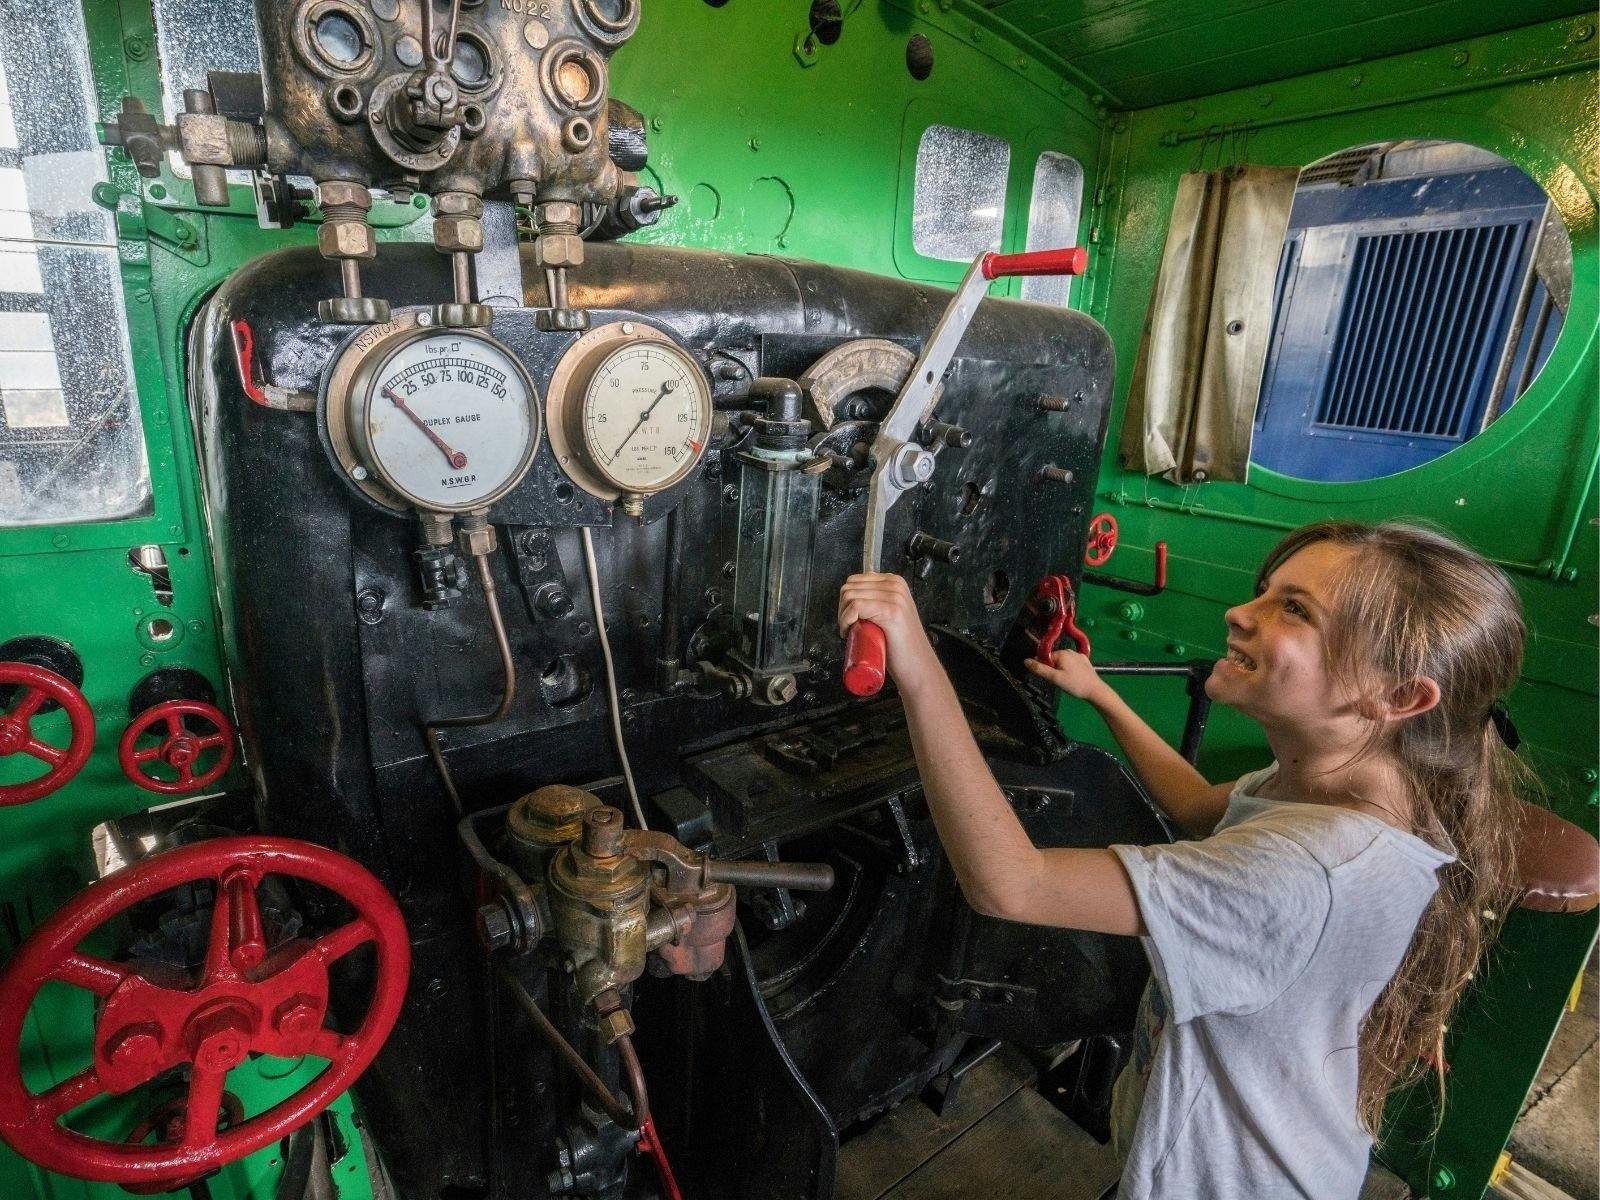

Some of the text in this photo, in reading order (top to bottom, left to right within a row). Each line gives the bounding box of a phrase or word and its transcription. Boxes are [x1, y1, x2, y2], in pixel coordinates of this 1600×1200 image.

[355, 318, 402, 352] NSWGR
[640, 361, 649, 371] 75
[610, 378, 620, 388] 50
[666, 379, 680, 389] 100
[423, 416, 451, 427] DUPLEX
[597, 413, 607, 423] 25
[677, 413, 688, 423] 125
[664, 446, 676, 456] 150
